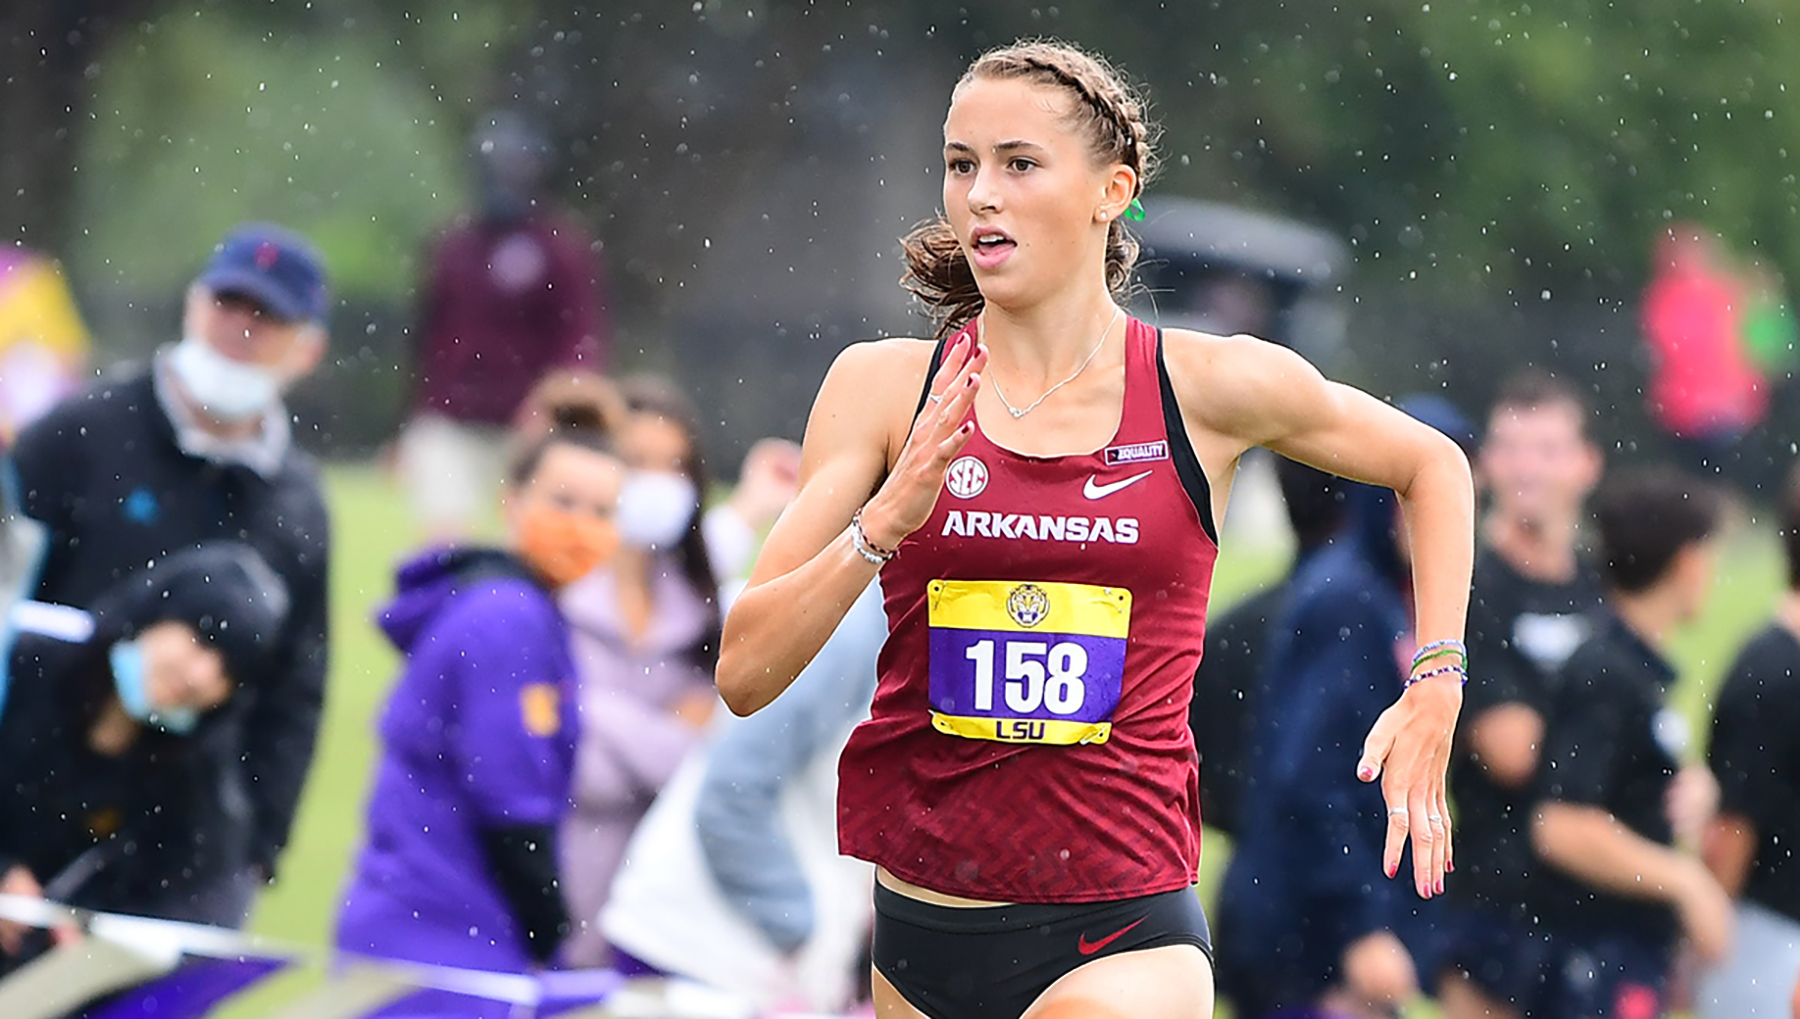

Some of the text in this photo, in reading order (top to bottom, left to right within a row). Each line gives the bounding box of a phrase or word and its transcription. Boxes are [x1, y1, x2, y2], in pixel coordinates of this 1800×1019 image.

[1117, 444, 1164, 460] EQUALITY
[948, 459, 986, 496] SEC
[941, 511, 1139, 544] ARKANSAS
[966, 640, 1088, 715] 158
[996, 721, 1045, 740] LSU
